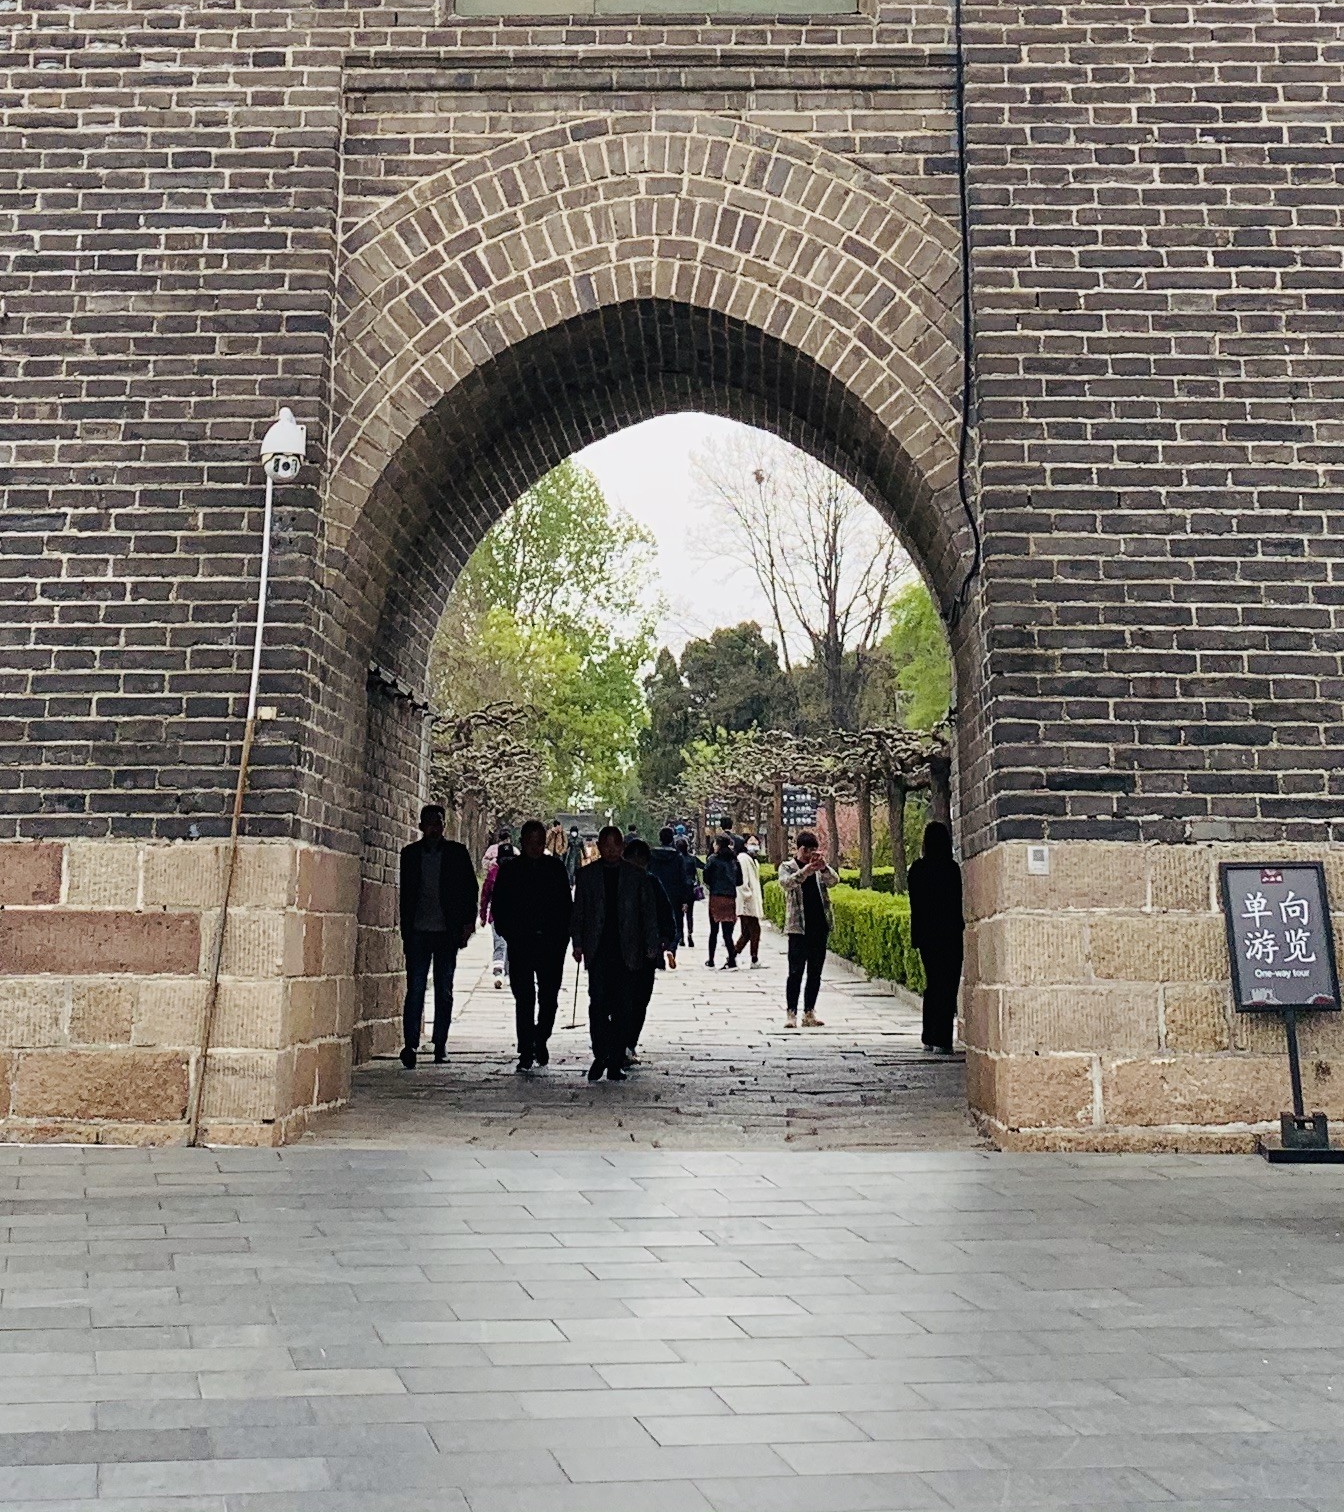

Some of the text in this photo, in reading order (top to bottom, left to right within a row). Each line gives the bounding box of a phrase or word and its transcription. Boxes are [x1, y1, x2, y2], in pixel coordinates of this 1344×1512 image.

[1242, 890, 1309, 928] 单向
[1244, 929, 1316, 964] 游览
[1254, 968, 1310, 979] One-way tour
